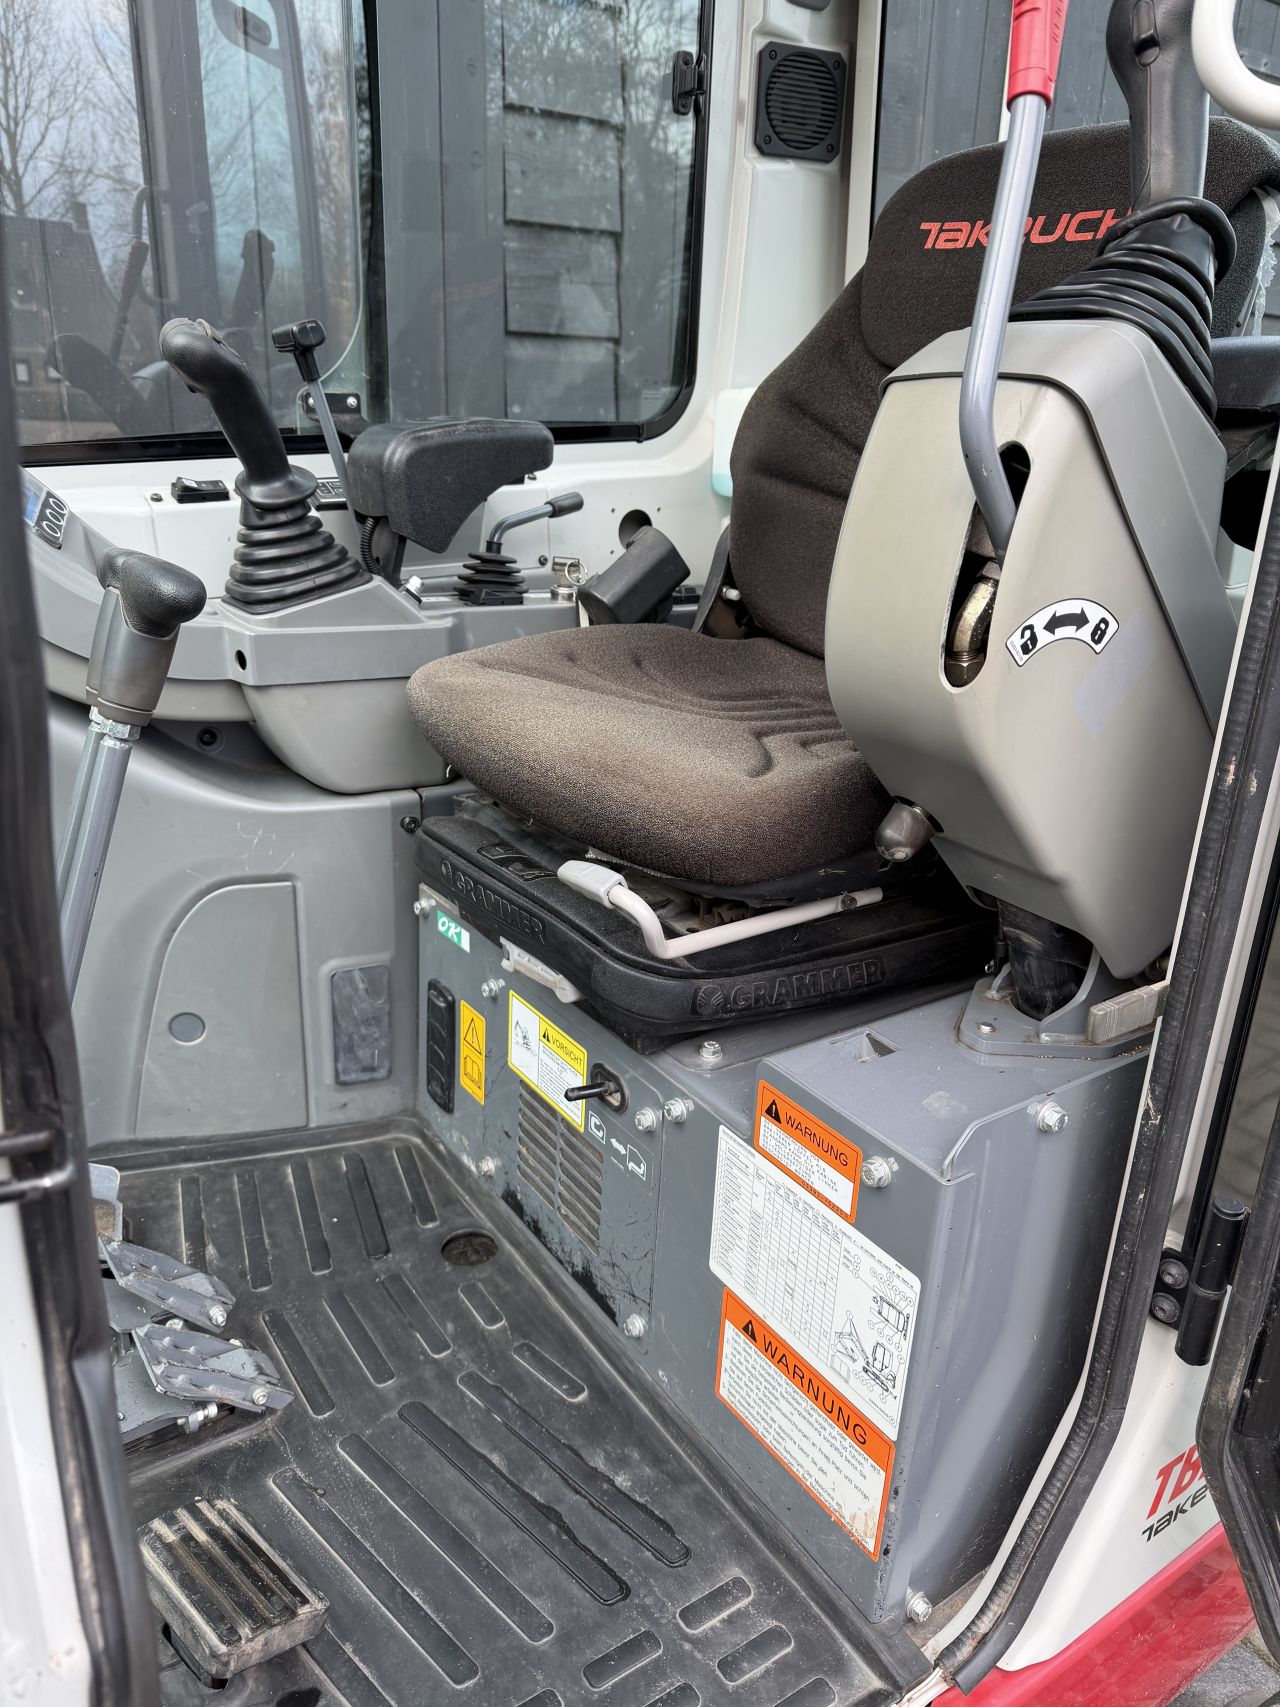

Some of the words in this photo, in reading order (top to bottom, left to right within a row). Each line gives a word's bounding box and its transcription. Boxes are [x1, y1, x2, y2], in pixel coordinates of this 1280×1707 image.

[437, 916, 461, 942] OK
[730, 959, 883, 1009] GRAMMER
[551, 1034, 582, 1067] VORSICHT
[784, 1111, 849, 1168] WARNUNG
[761, 1333, 868, 1447] WARNUNG
[1146, 1443, 1205, 1520] TB
